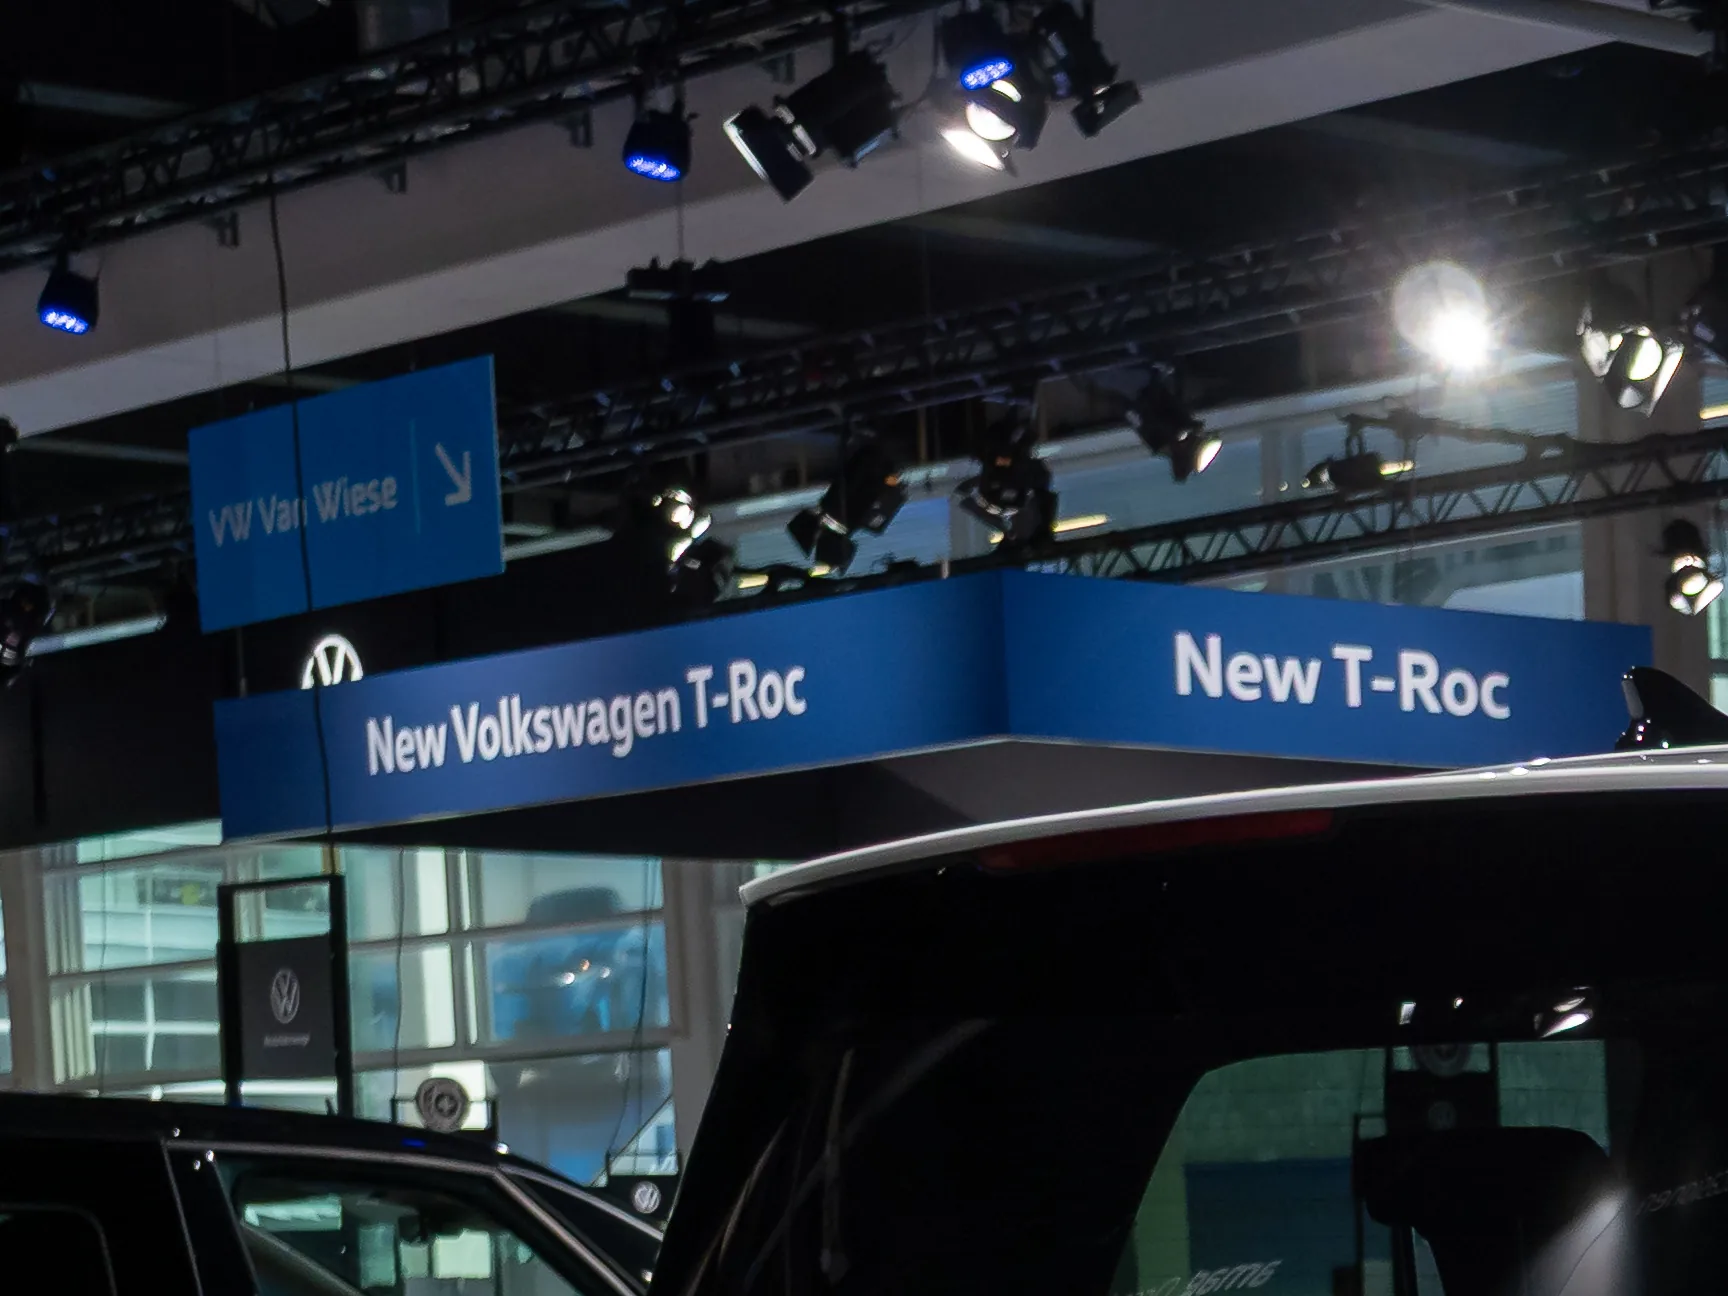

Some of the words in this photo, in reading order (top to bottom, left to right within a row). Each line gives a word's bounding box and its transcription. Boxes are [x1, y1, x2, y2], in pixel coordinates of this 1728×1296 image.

[208, 497, 252, 548] VW
[257, 492, 309, 536] Van
[312, 472, 400, 524] Wiese
[366, 712, 448, 777] New
[449, 690, 683, 763] Volkswagen
[685, 657, 808, 729] T-Roc
[1173, 630, 1322, 706] New
[1331, 642, 1512, 720] T-Roc
